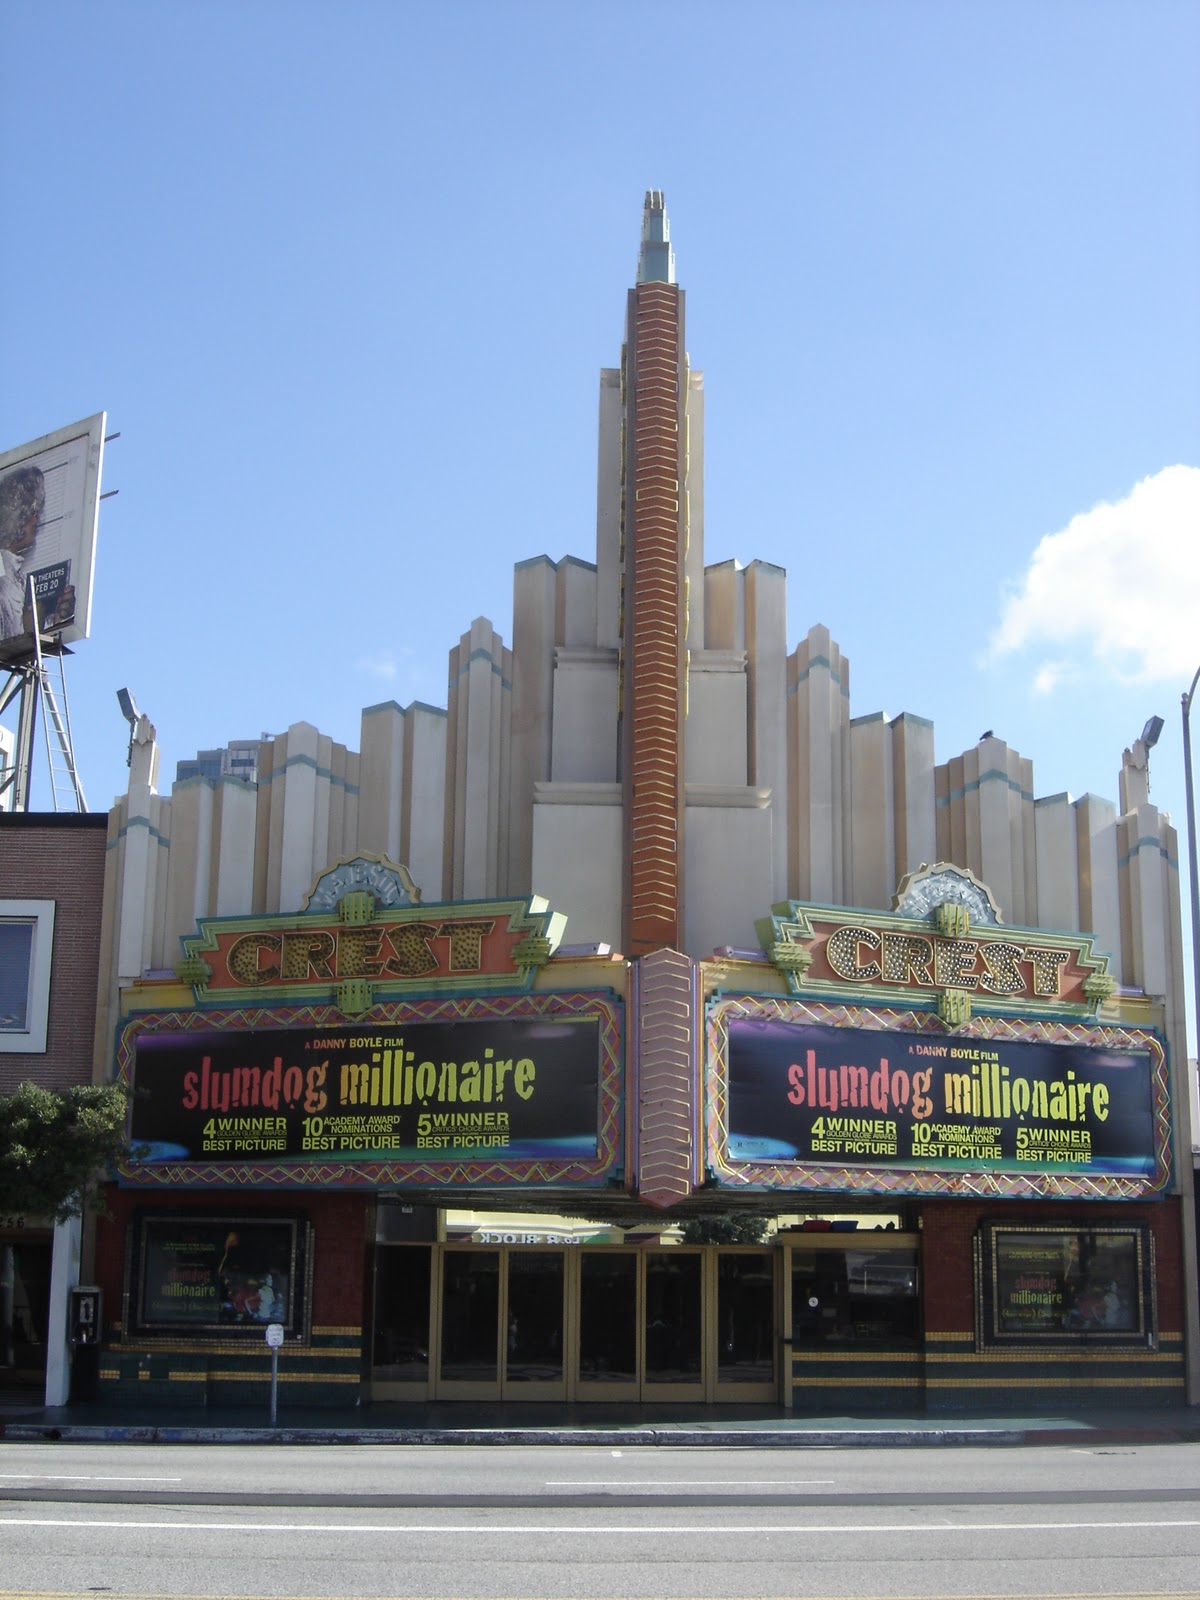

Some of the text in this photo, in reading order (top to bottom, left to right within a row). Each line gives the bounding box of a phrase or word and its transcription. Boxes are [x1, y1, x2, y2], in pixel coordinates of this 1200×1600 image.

[38, 568, 65, 582] THEATERS
[36, 579, 59, 594] FEB 20
[227, 920, 496, 987] CREST
[826, 925, 1072, 996] CREST
[313, 1038, 346, 1049] DANNY
[349, 1037, 382, 1048] BOYLE
[384, 1038, 404, 1047] FILM
[908, 1045, 999, 1061] A DANNY BOYLE FILM
[183, 1048, 536, 1113] slumdog millionaire
[787, 1049, 1109, 1122] slumdog millionaire
[203, 1117, 287, 1139] 4 WINNER
[302, 1115, 400, 1137] 10 ACADEMY AWARD
[331, 1124, 393, 1134] NOMINATIONS
[417, 1112, 509, 1136] 5 WINNER
[811, 1116, 897, 1139] 4 WINNER
[826, 1130, 851, 1138] GOLDEN
[911, 1122, 1001, 1143] 10 ACADEMY AWARD
[938, 1133, 995, 1143] NOMINATIONS
[1016, 1127, 1091, 1149] 5 WINNER
[203, 1140, 232, 1151] BEST
[235, 1139, 285, 1151] PICTURE
[302, 1137, 337, 1150] BEST
[340, 1136, 400, 1150] PICTURE
[417, 1135, 510, 1148] BEST PICTURE
[811, 1140, 842, 1153] BEST
[845, 1141, 895, 1155] PICTURE
[912, 1143, 945, 1157] BEST
[948, 1145, 1002, 1160] PICTURE
[1016, 1149, 1092, 1163] BEST PICTURE
[161, 1282, 215, 1297] millionaire
[1010, 1290, 1063, 1305] millionaire
